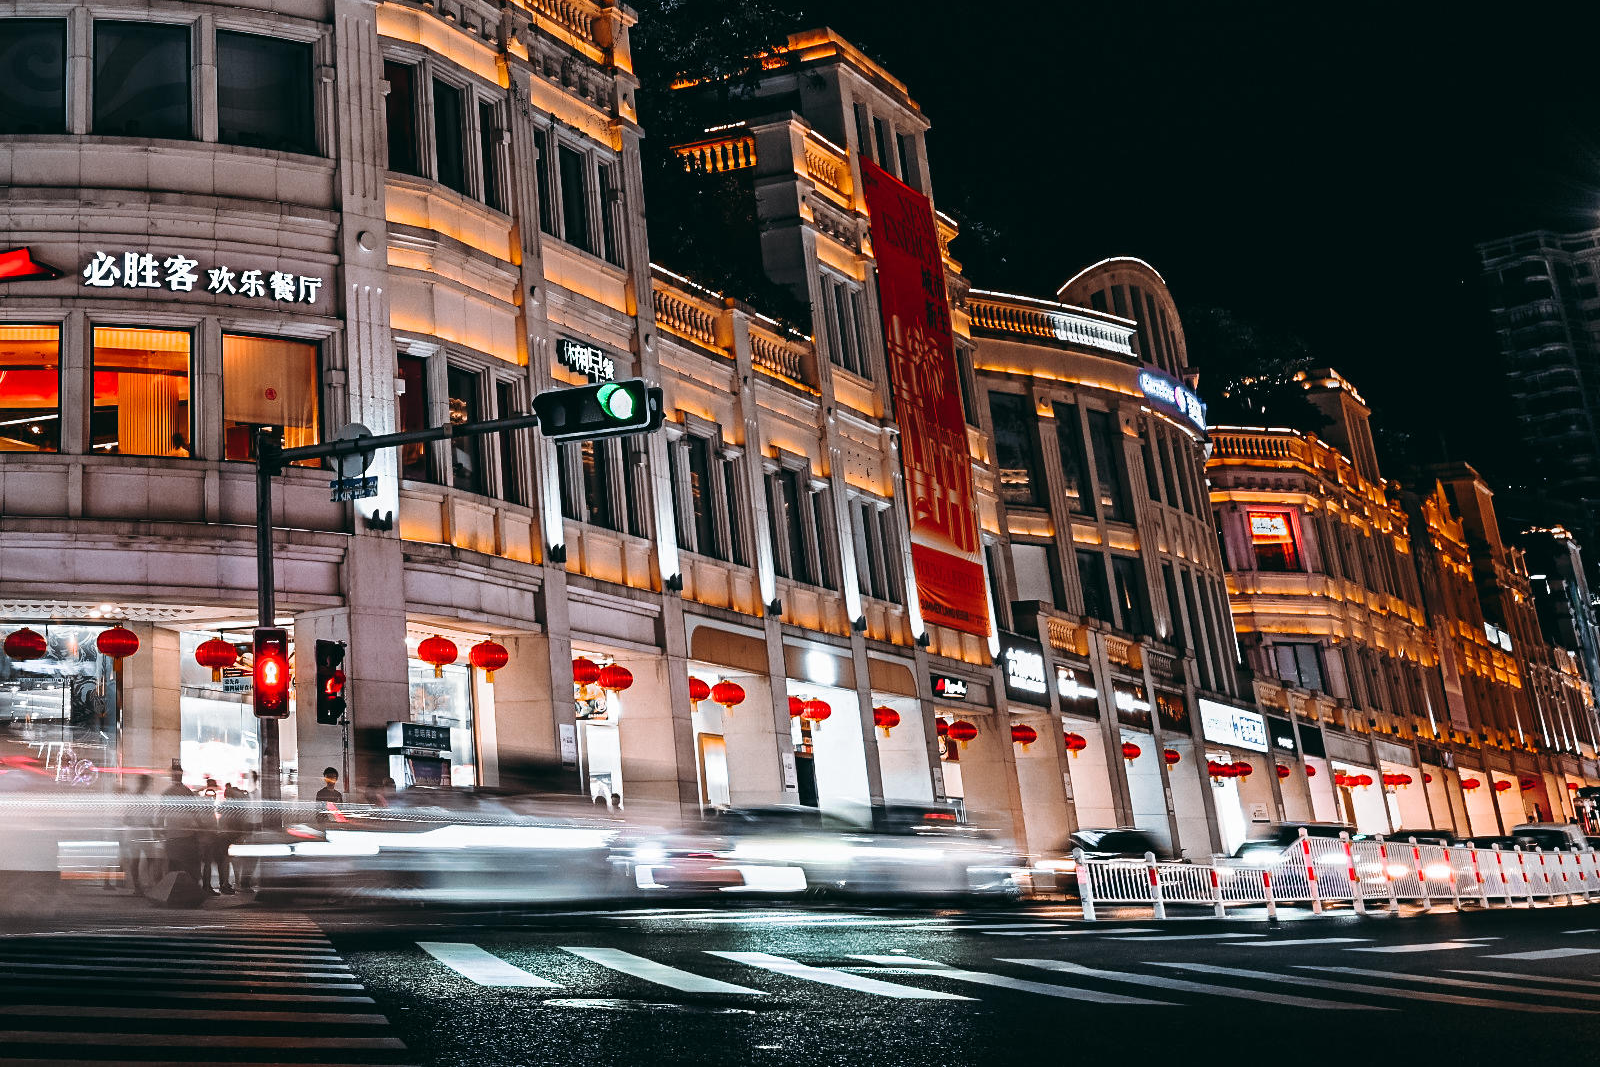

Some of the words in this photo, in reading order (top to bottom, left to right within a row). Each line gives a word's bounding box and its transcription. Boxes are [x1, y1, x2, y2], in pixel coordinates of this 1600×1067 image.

[83, 251, 199, 292] 必胜客
[207, 266, 323, 304] 欢乐餐厅
